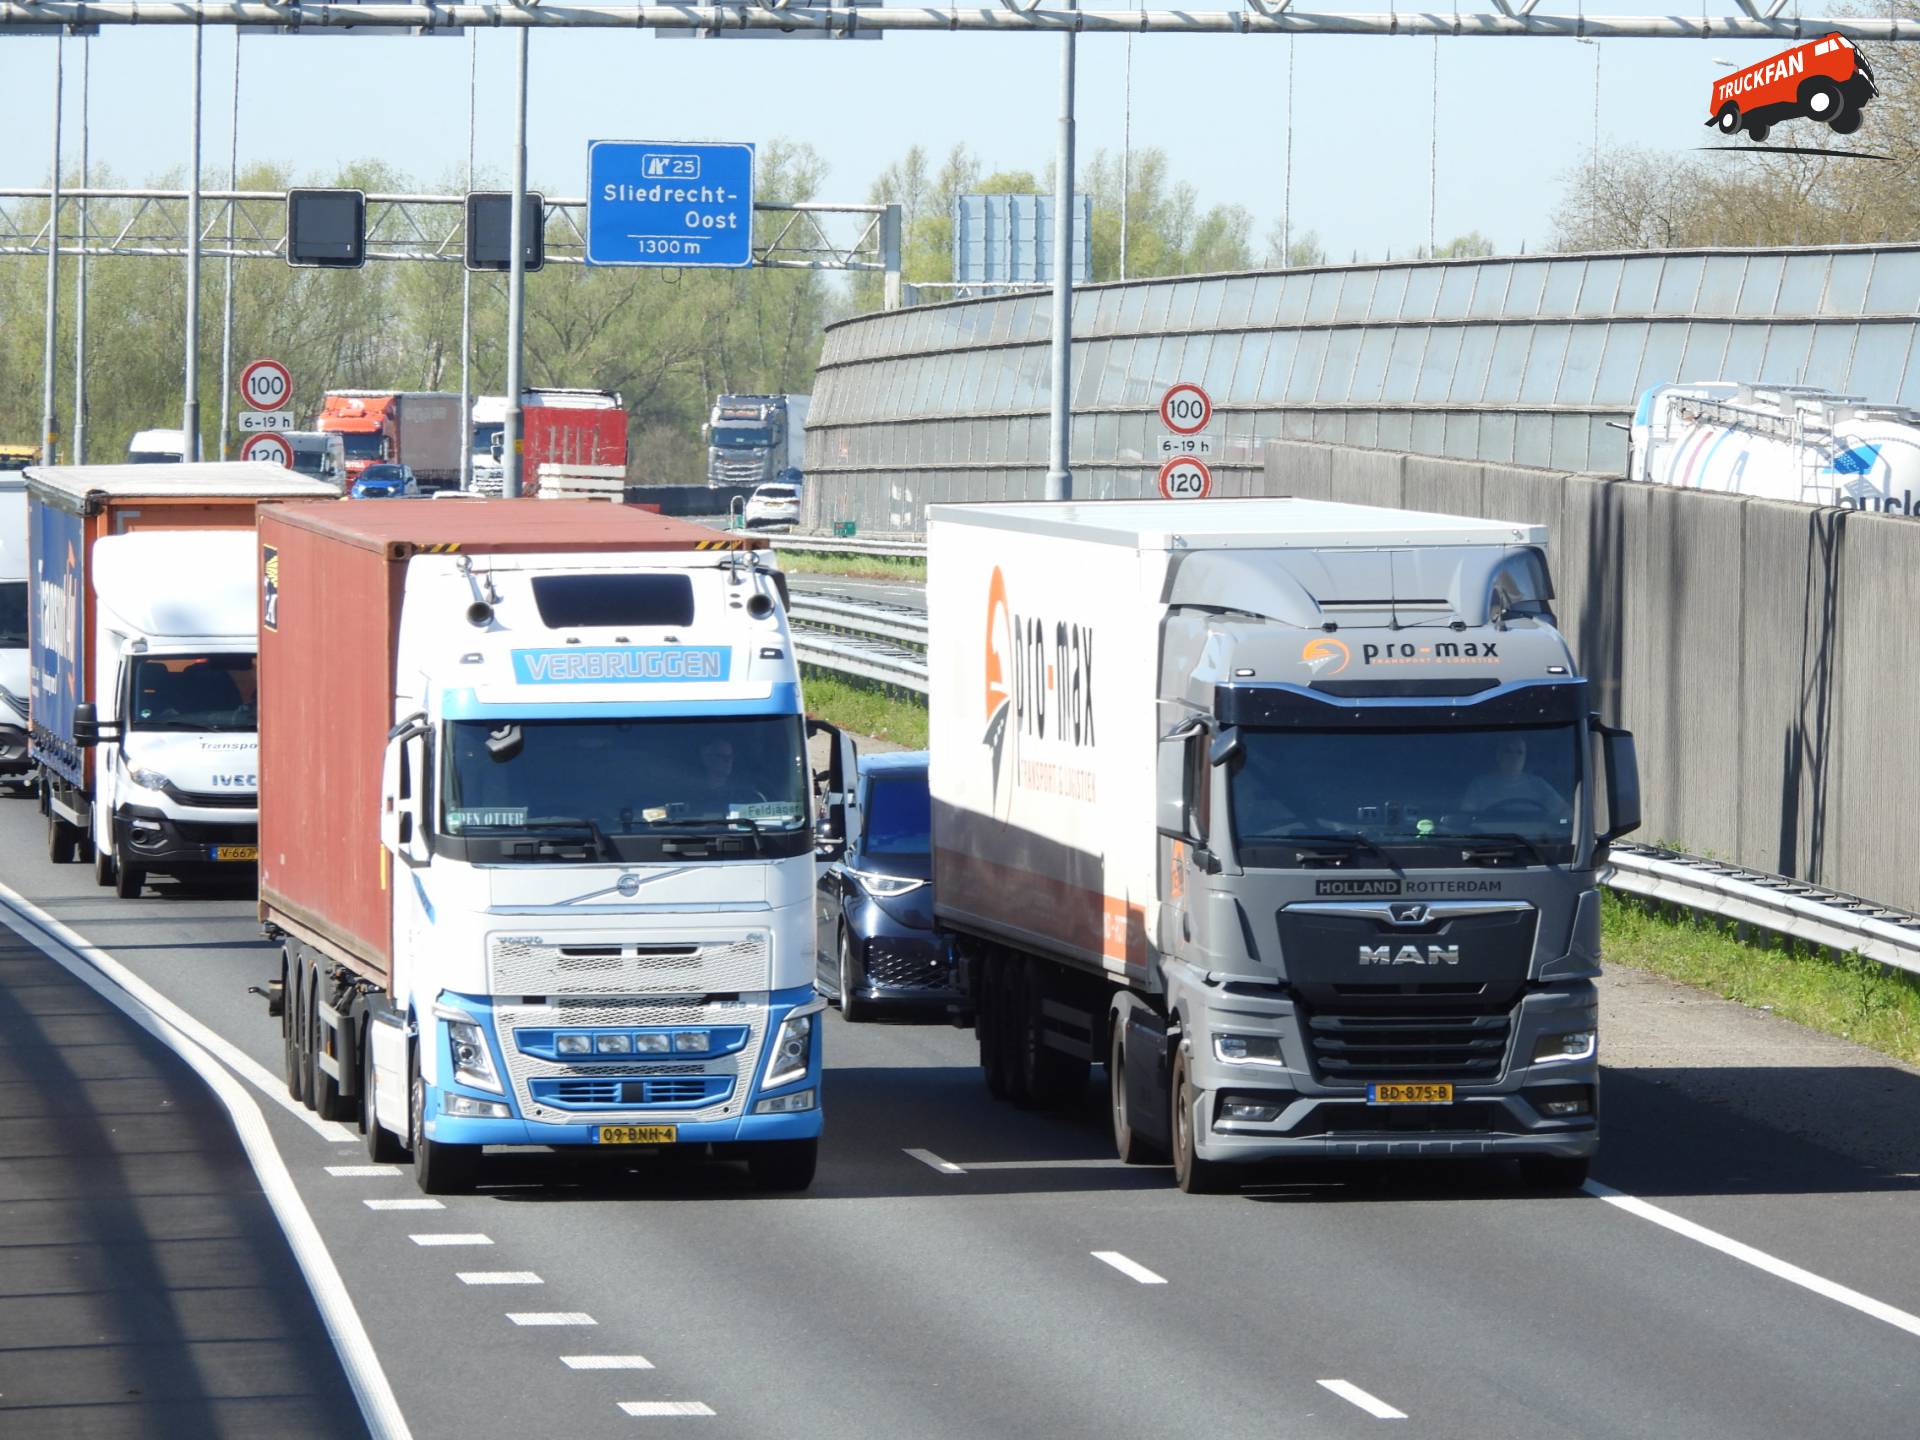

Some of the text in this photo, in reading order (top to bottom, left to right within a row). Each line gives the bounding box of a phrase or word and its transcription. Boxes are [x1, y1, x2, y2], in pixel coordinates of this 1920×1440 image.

[672, 160, 695, 173] 25
[603, 184, 737, 203] Sliedrecht-
[684, 210, 737, 229] Oost
[639, 240, 700, 254] 1300 m
[250, 376, 284, 395] 100
[1169, 400, 1203, 419] 100
[244, 416, 290, 428] 6-19 h
[1162, 440, 1209, 452] 6-19 h
[1169, 473, 1202, 492] 120
[1362, 642, 1499, 665] pro-max
[524, 651, 720, 681] VERBRUGGEN
[1014, 613, 1095, 788] pro-max
[200, 742, 258, 750] Transpo
[212, 774, 257, 786] IVEC
[1318, 879, 1502, 894] HOLLAND ROTTERDAM
[1359, 945, 1460, 966] MAN
[603, 1127, 673, 1142] 09-BNH-4
